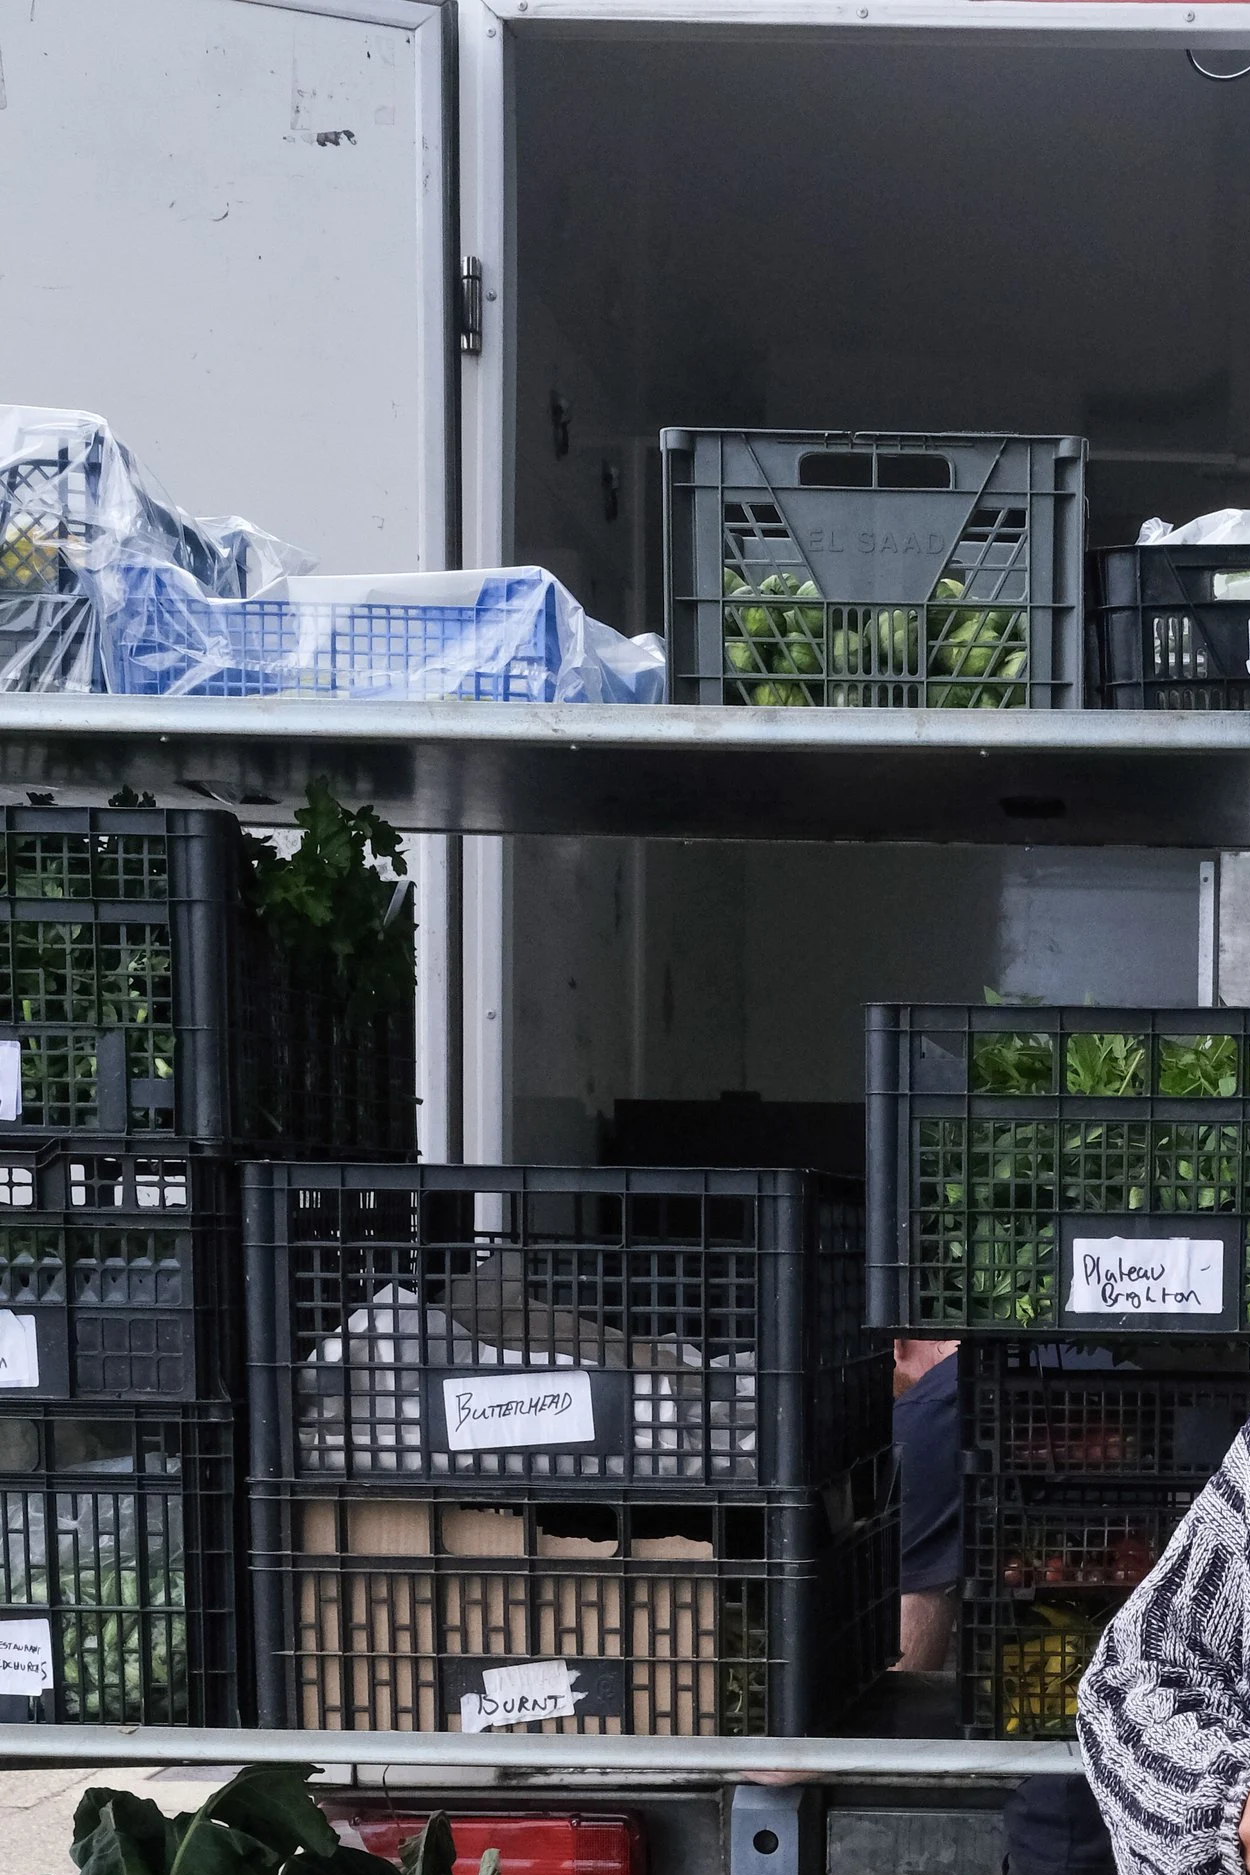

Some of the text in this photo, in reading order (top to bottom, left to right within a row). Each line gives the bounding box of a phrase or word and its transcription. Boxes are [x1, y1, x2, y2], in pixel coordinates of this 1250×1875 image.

[808, 530, 946, 555] EL SAAD
[1083, 1253, 1166, 1286] Plateau
[1101, 1282, 1202, 1309] Brighton
[477, 1694, 566, 1716] BURNT
